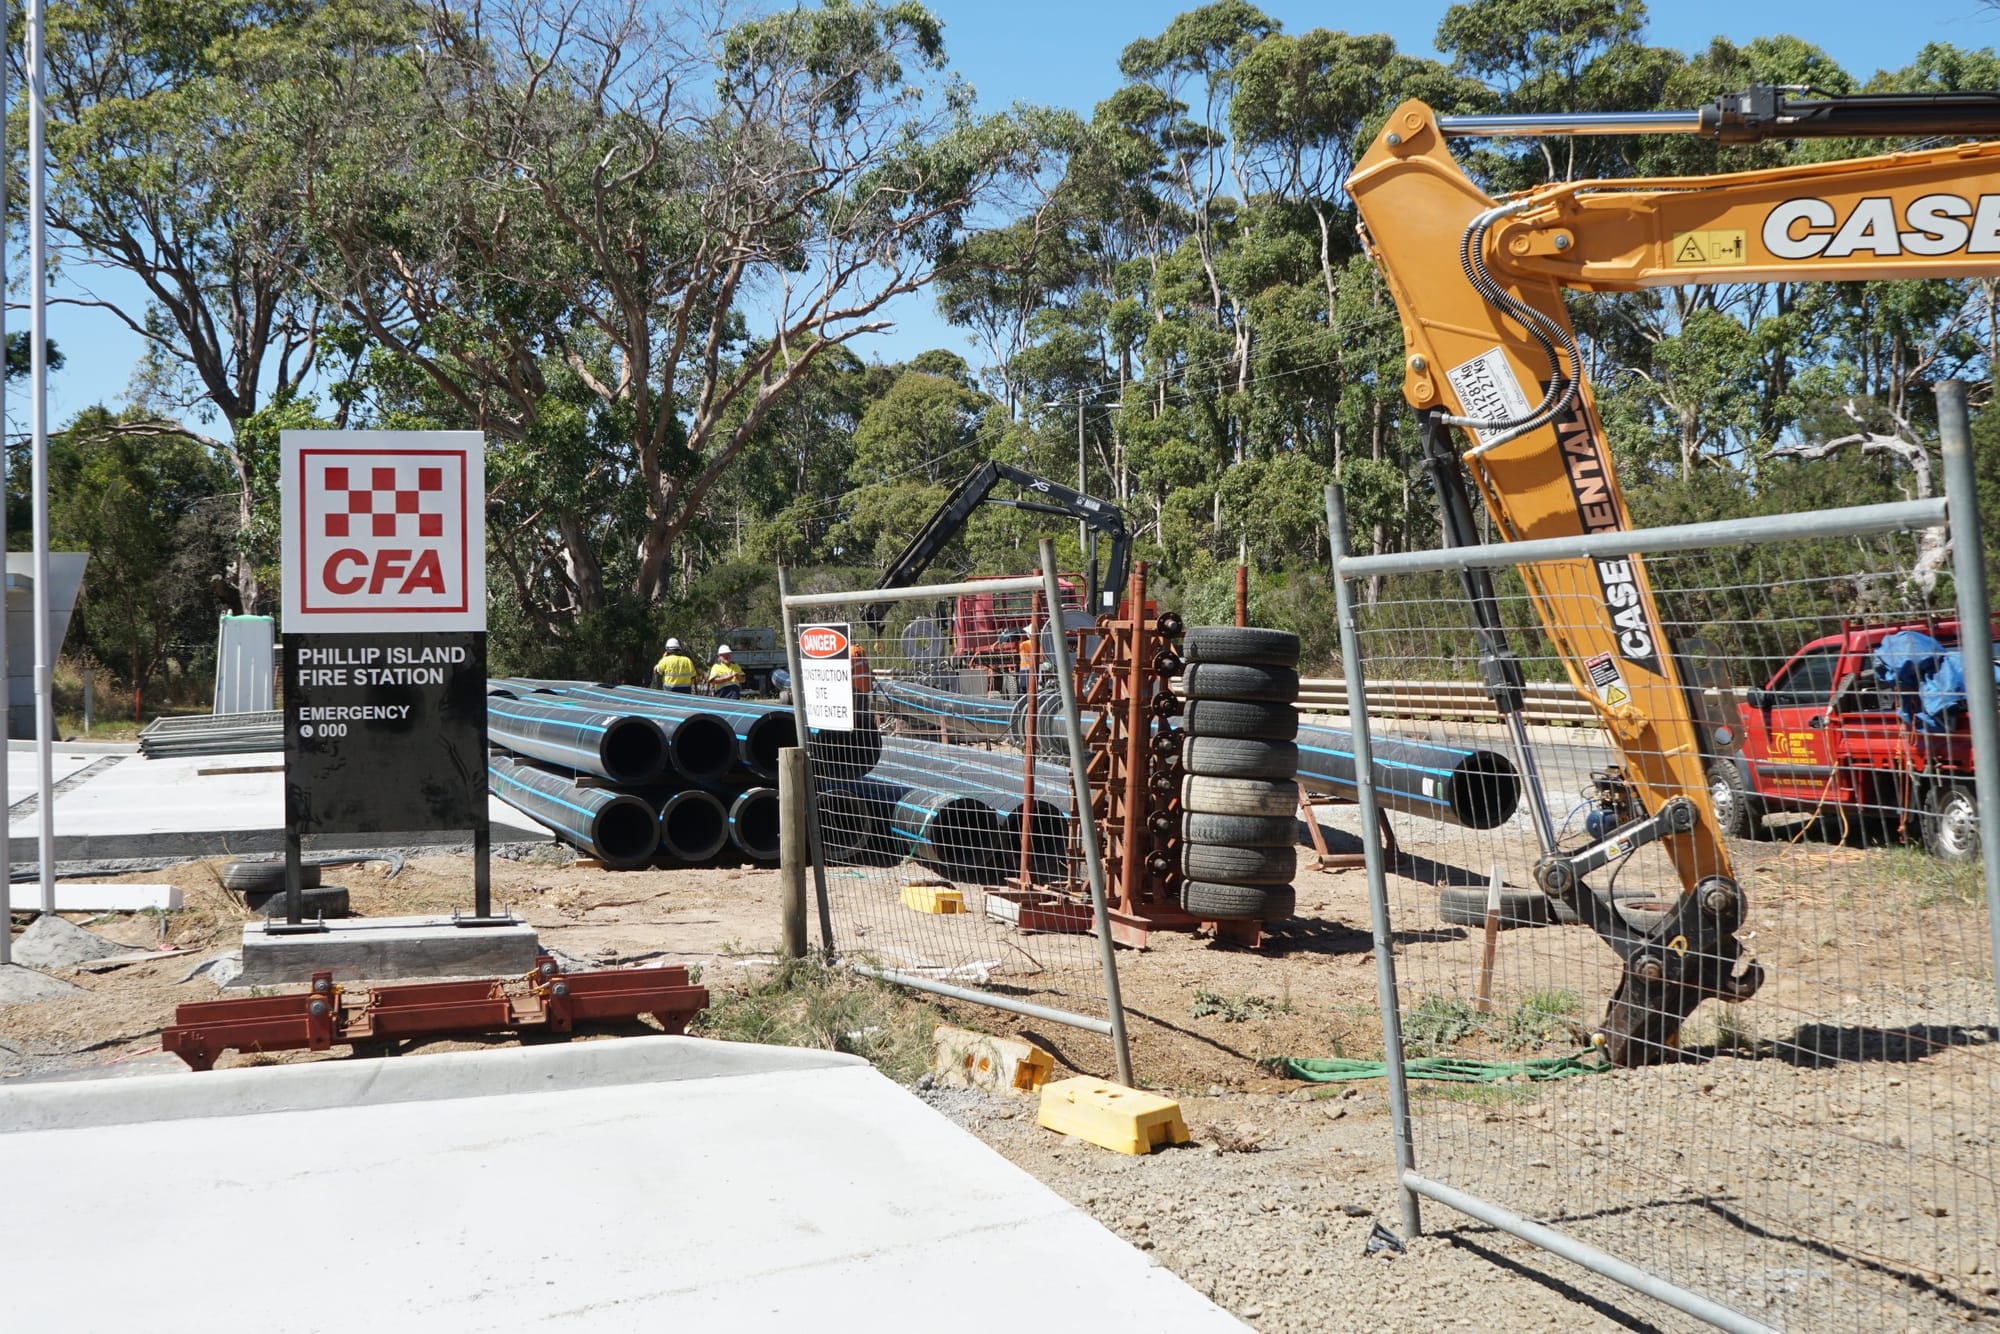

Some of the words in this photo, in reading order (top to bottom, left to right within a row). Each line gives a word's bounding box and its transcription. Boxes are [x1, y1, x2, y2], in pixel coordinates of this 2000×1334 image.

[1461, 364, 1473, 380] Kg
[1473, 358, 1486, 374] Kg
[1453, 377, 1474, 412] CAPACITY
[1465, 380, 1487, 412] 1281
[1476, 375, 1501, 405] 1127
[1481, 411, 1502, 436] SLL
[1029, 478, 1051, 492] XS
[322, 548, 446, 595] CFA
[1598, 558, 1652, 660] CASE
[804, 634, 837, 651] DANGER
[297, 647, 381, 665] PHILLIP
[387, 646, 466, 664] ISLAND
[299, 669, 348, 686] FIRE
[353, 668, 444, 685] STATION
[299, 705, 410, 721] EMERGENCY
[824, 705, 848, 719] ENTER
[318, 723, 348, 737] 000
